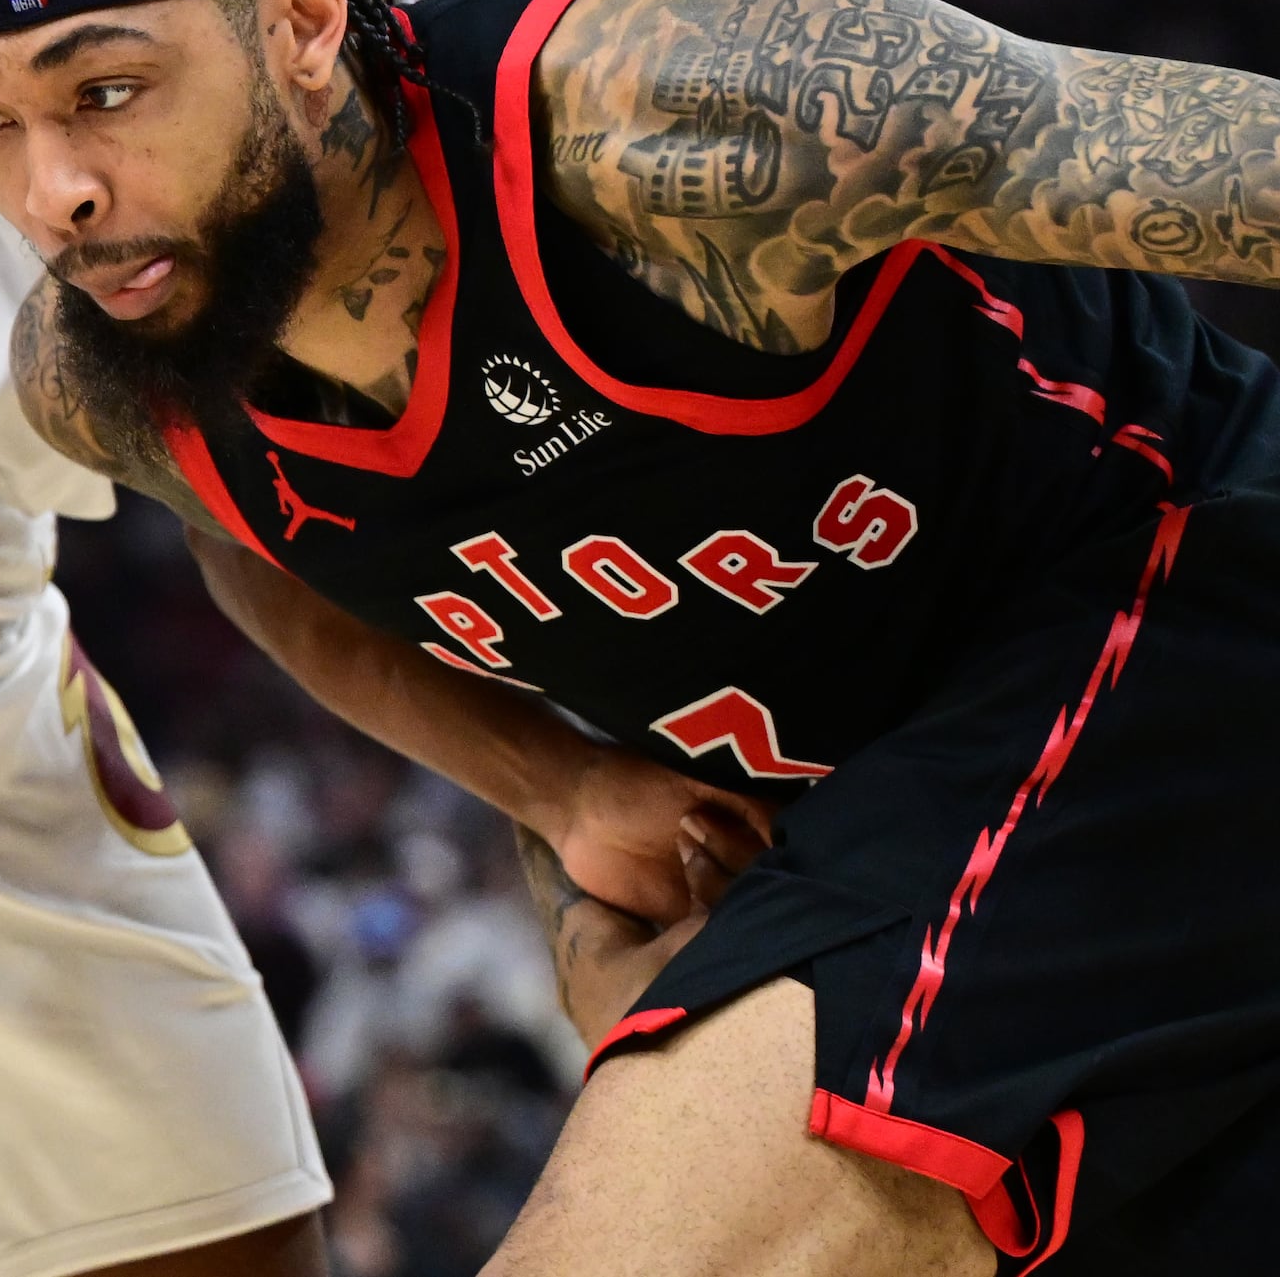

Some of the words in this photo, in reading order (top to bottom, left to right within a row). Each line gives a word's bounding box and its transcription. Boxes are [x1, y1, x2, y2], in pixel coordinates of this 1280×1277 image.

[513, 436, 569, 477] Sun
[558, 409, 613, 446] Life
[413, 473, 919, 690] PTORS
